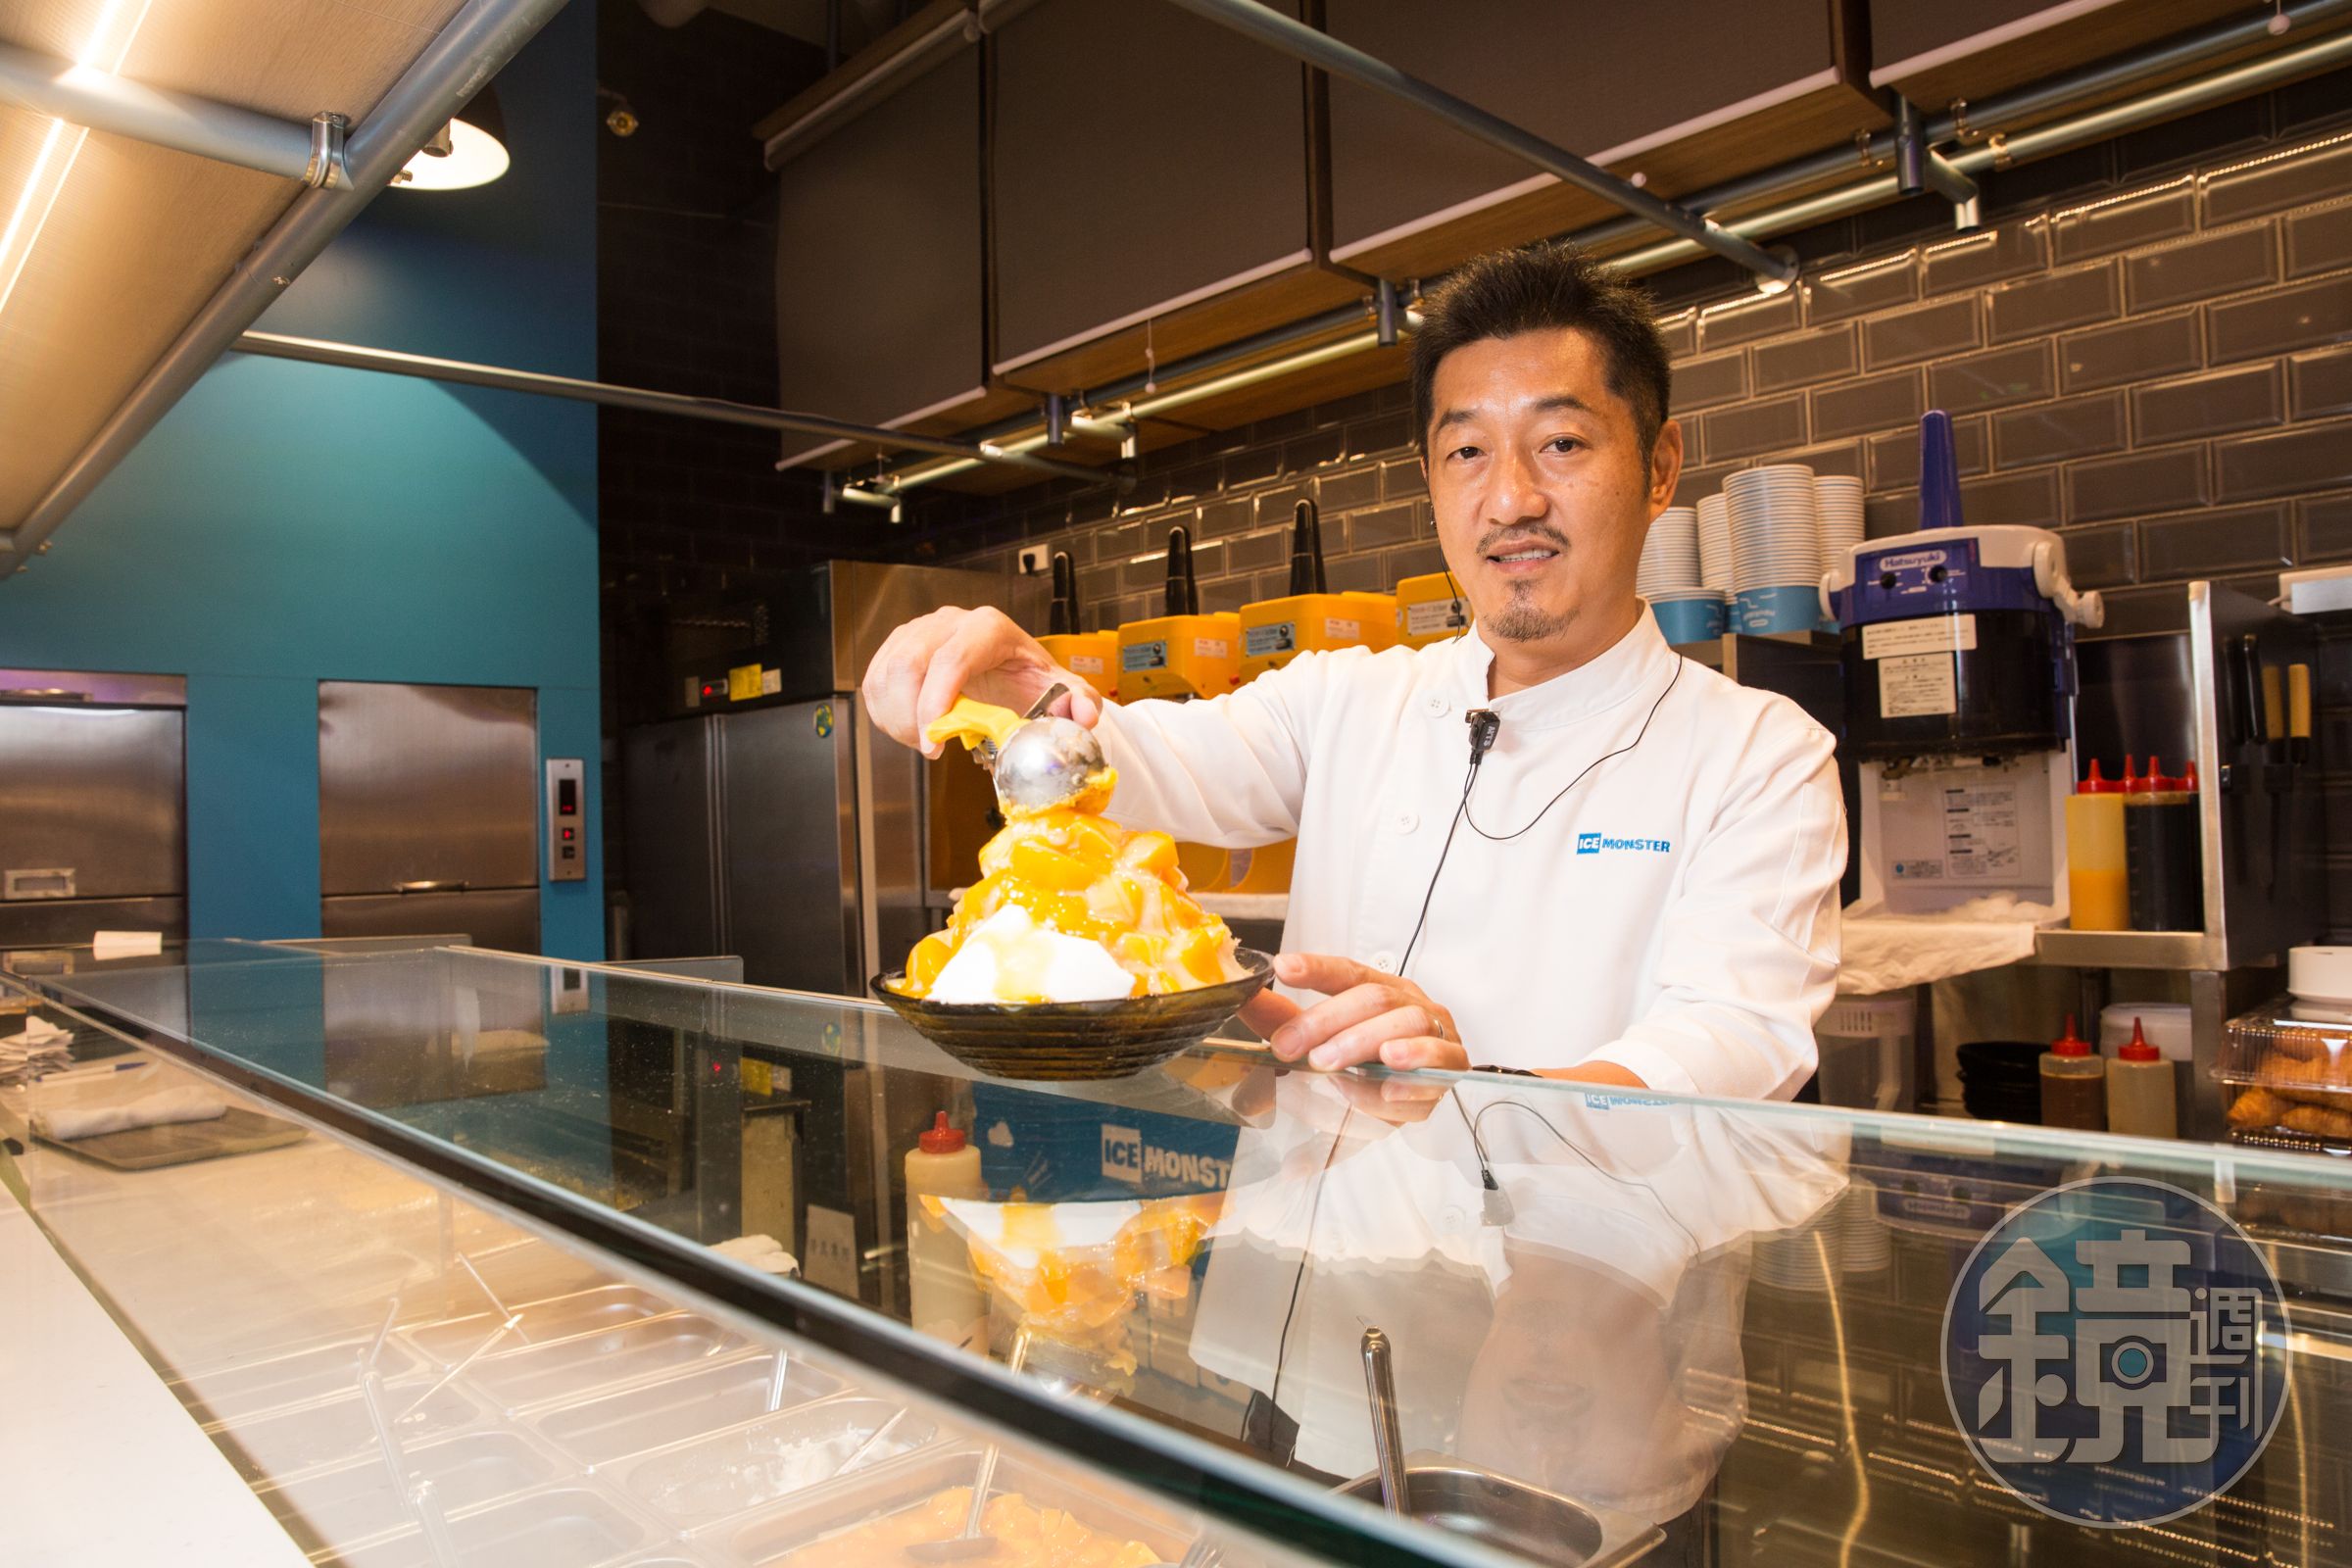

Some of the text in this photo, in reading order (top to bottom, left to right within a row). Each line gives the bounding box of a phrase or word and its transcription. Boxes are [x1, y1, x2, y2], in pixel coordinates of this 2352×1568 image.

[1579, 836, 1671, 853] ICE MONSTER
[1103, 1135, 1140, 1173] ICE
